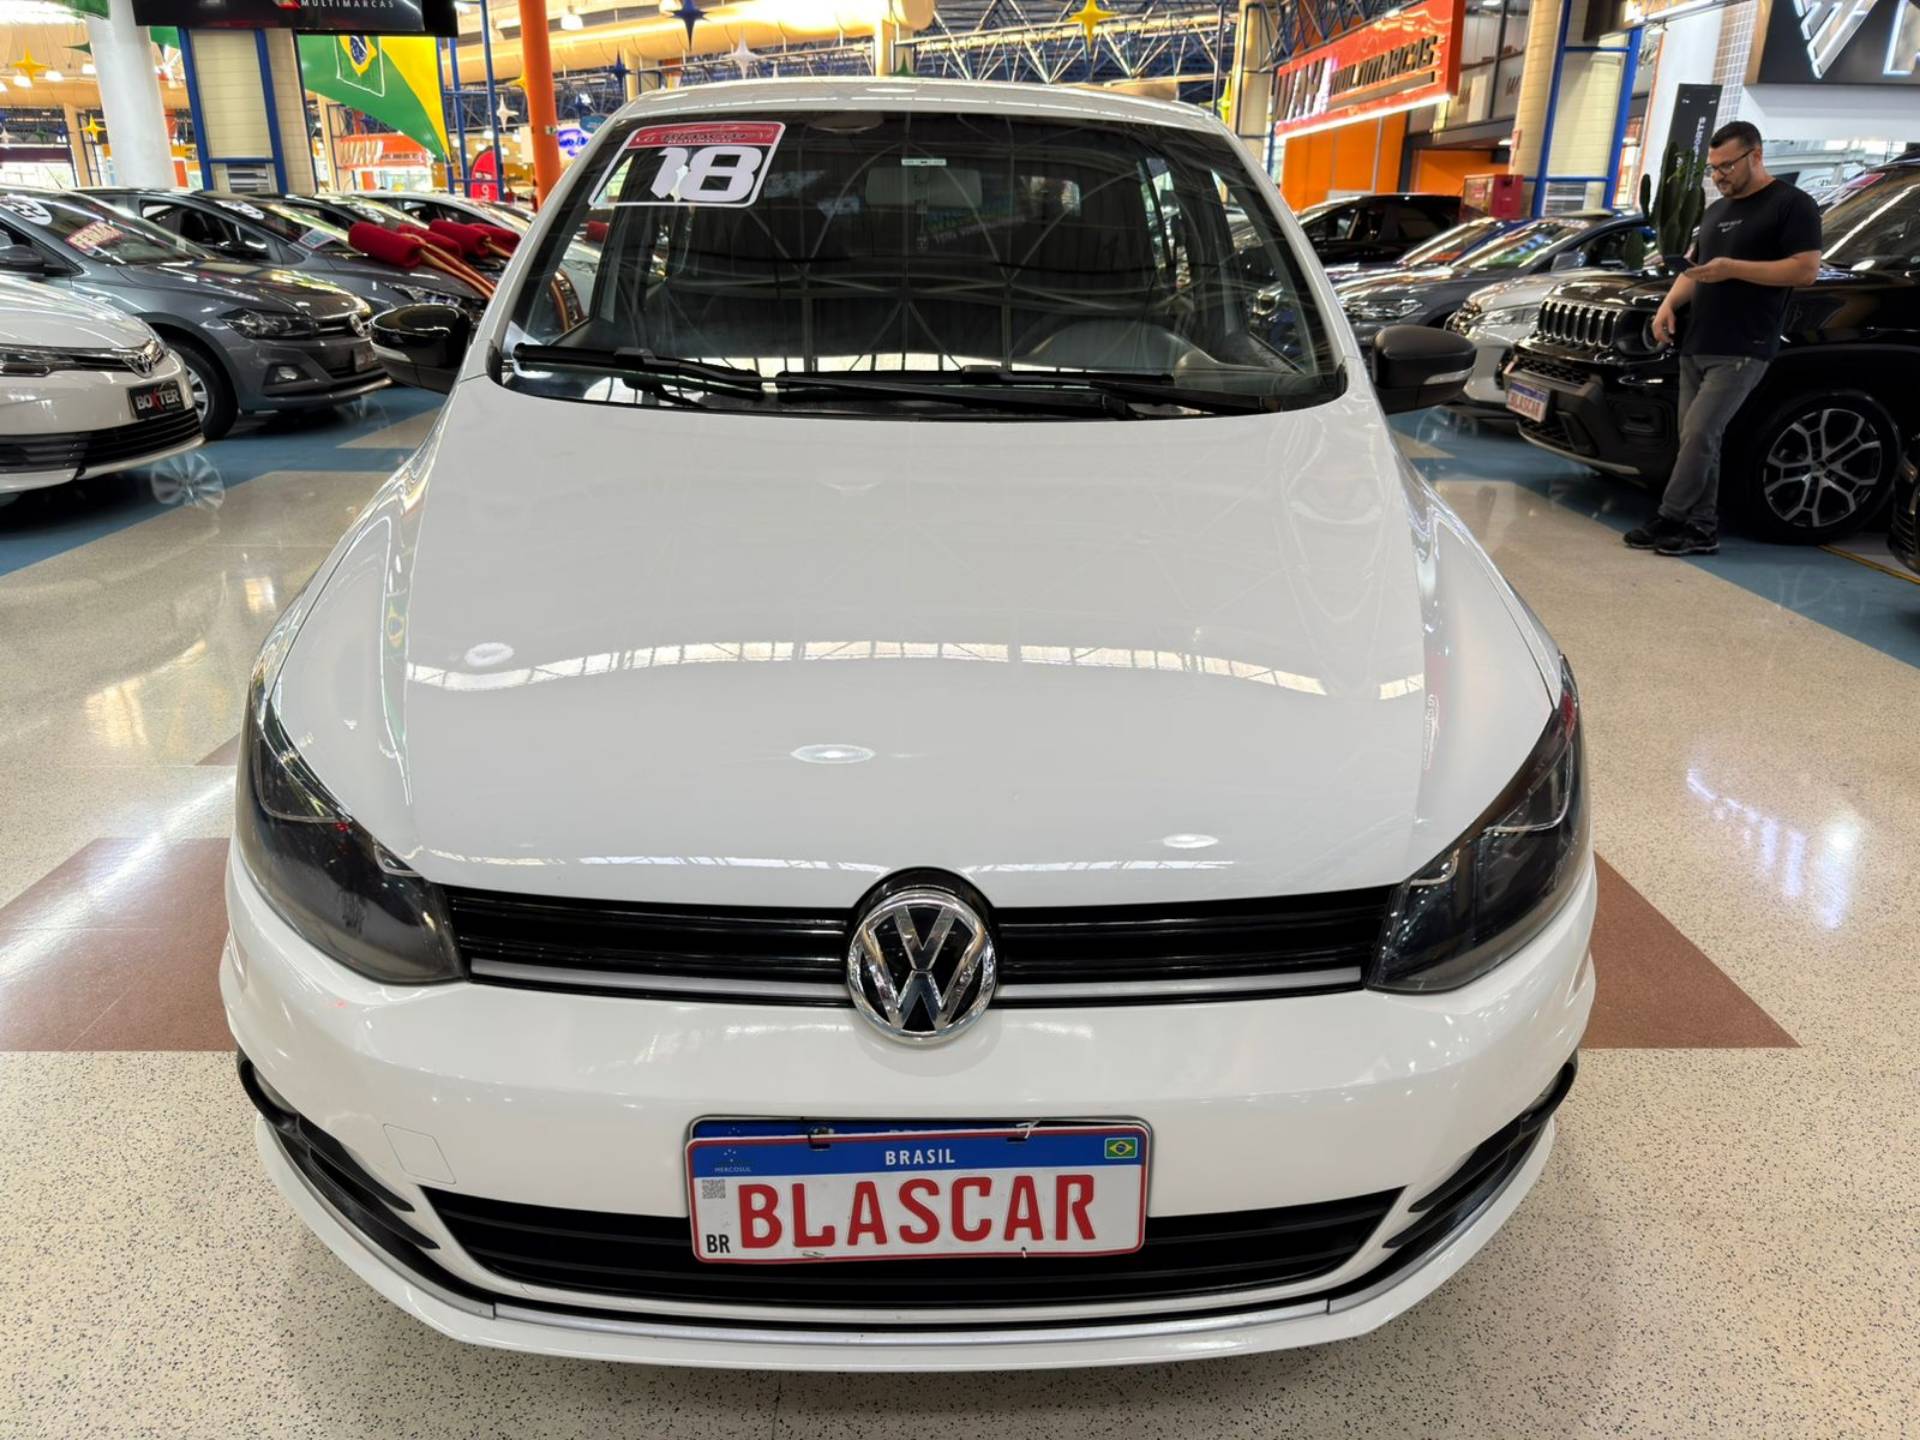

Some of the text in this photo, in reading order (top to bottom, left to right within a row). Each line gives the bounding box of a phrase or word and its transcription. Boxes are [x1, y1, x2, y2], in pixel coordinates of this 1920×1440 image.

[300, 0, 394, 8] MULTIMARCAS
[1271, 35, 1439, 121] WAY MULTIMARCAS
[650, 146, 763, 203] 18
[135, 388, 180, 411] BOXTER
[885, 1149, 955, 1166] BRASIL
[738, 1174, 1096, 1249] BLASCAR
[706, 1234, 731, 1254] BR
